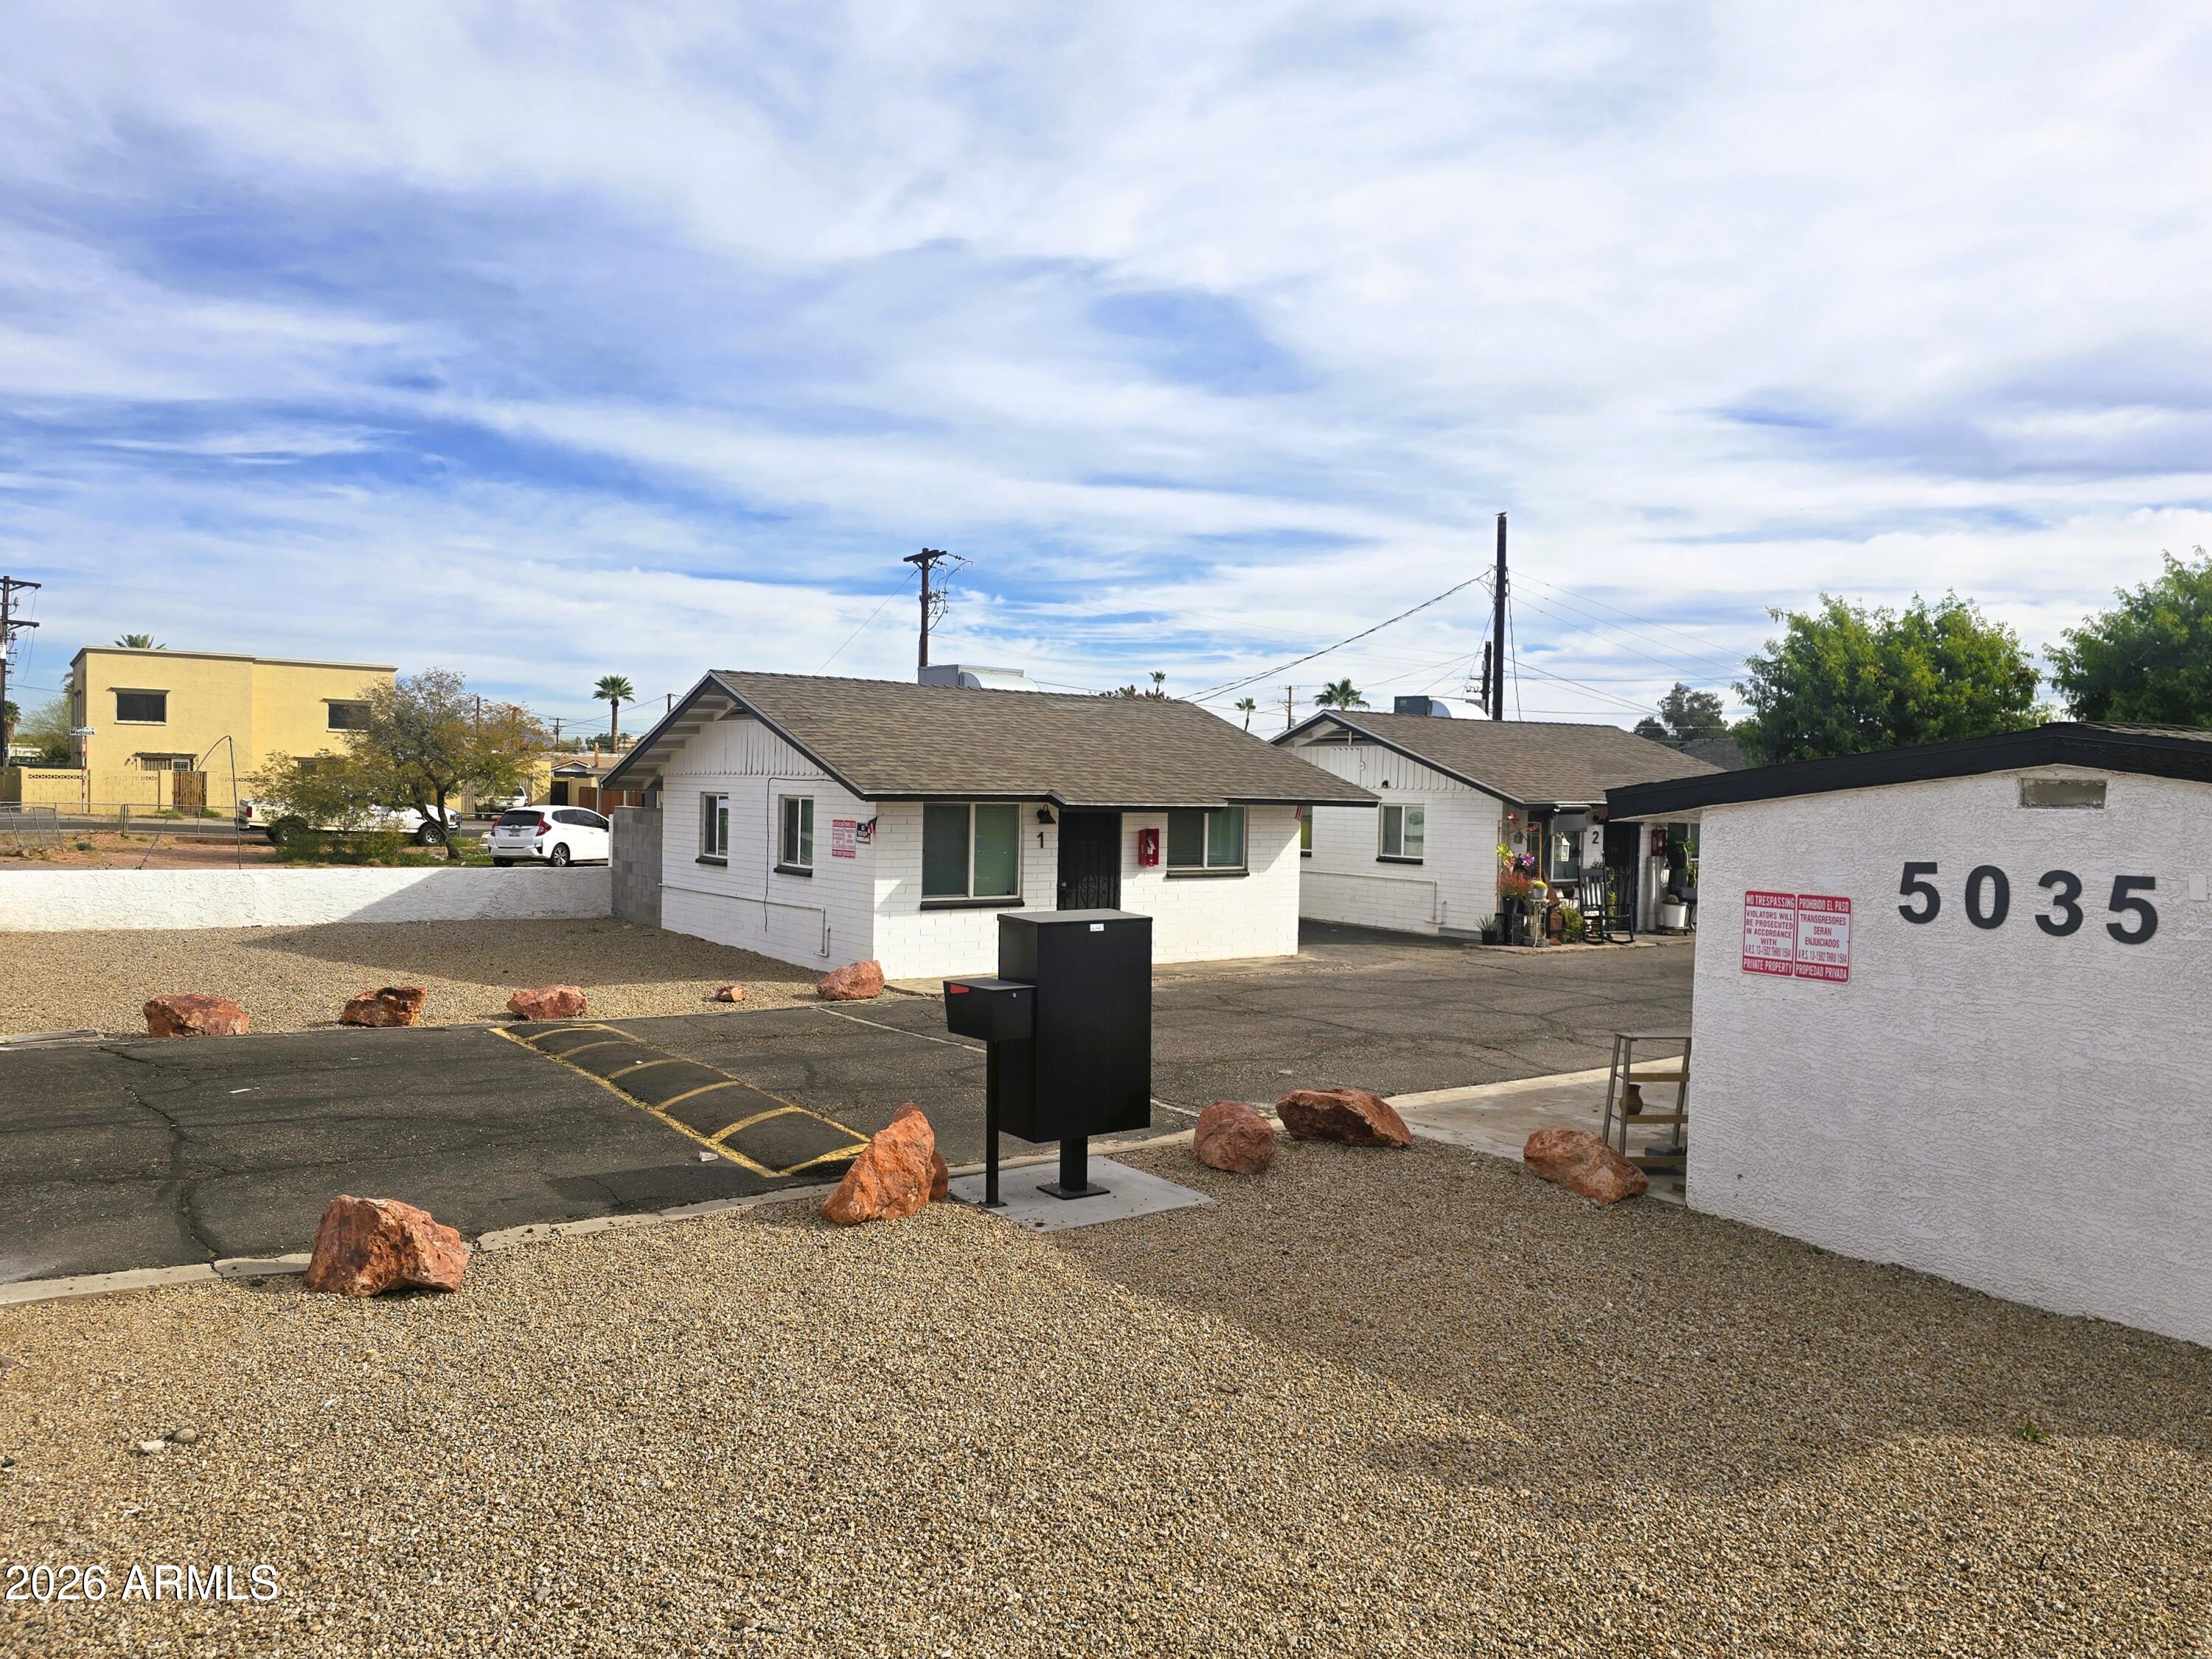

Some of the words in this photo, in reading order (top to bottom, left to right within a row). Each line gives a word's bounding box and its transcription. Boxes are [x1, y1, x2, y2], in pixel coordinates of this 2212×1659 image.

[1037, 832, 1043, 848] 1
[1593, 831, 1599, 844] 2
[1746, 894, 1754, 905] NO
[1755, 894, 1795, 908] TRESPASSING
[1799, 897, 1826, 911] PROHIBIDO
[1827, 900, 1833, 911] EL
[1835, 900, 1849, 912] PASO
[1899, 862, 2157, 945] 5035
[1747, 910, 1777, 919] VIOLATORS
[1779, 912, 1792, 921] WILL
[1800, 914, 1846, 926] TRANSGRESORES
[1756, 919, 1793, 930] PROSECUTED
[1746, 927, 1752, 935] IN
[1754, 928, 1792, 939] ACCORDANCE
[1813, 926, 1832, 936] SERAN
[1761, 937, 1777, 946] WITH
[1805, 936, 1840, 948] ENJUICIADOS
[1744, 958, 1763, 970] PRIVATE
[1765, 960, 1792, 973] PROPERTY
[1796, 963, 1823, 977] PROPIEDAD
[1825, 967, 1847, 980] PRIVADA
